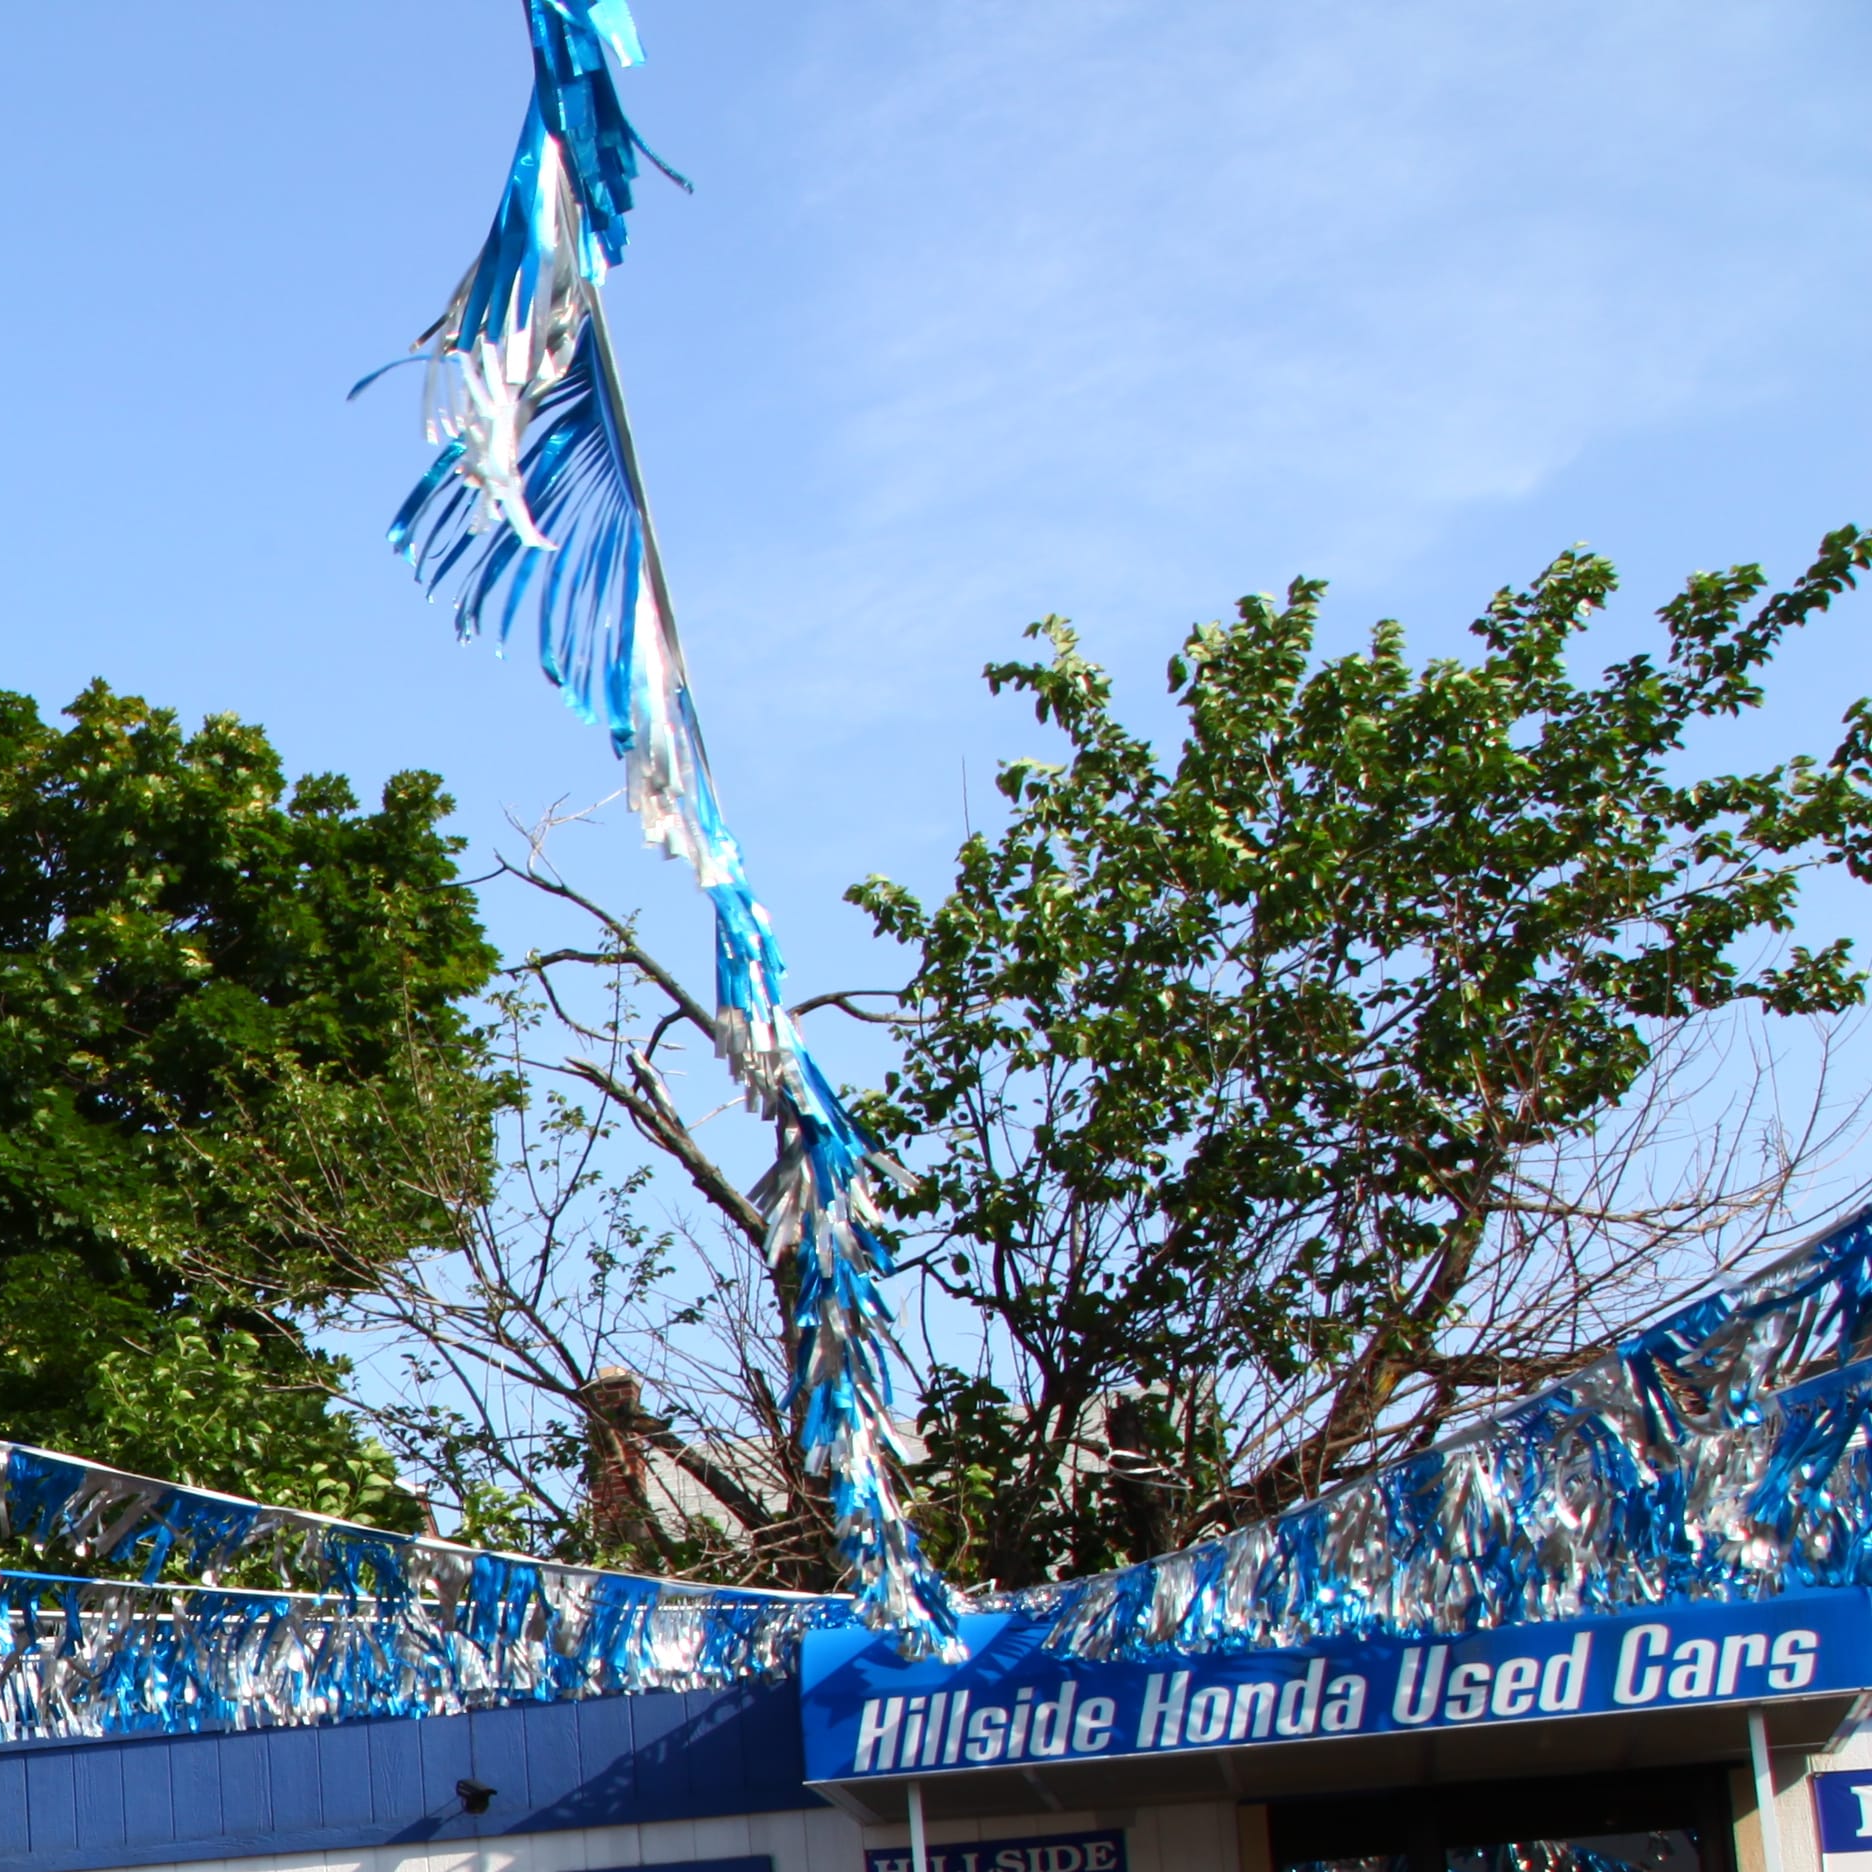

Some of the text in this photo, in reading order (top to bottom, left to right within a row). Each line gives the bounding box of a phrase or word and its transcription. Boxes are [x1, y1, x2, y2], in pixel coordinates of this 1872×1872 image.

[853, 1623, 1819, 1772] Hillside Honda Used Cars
